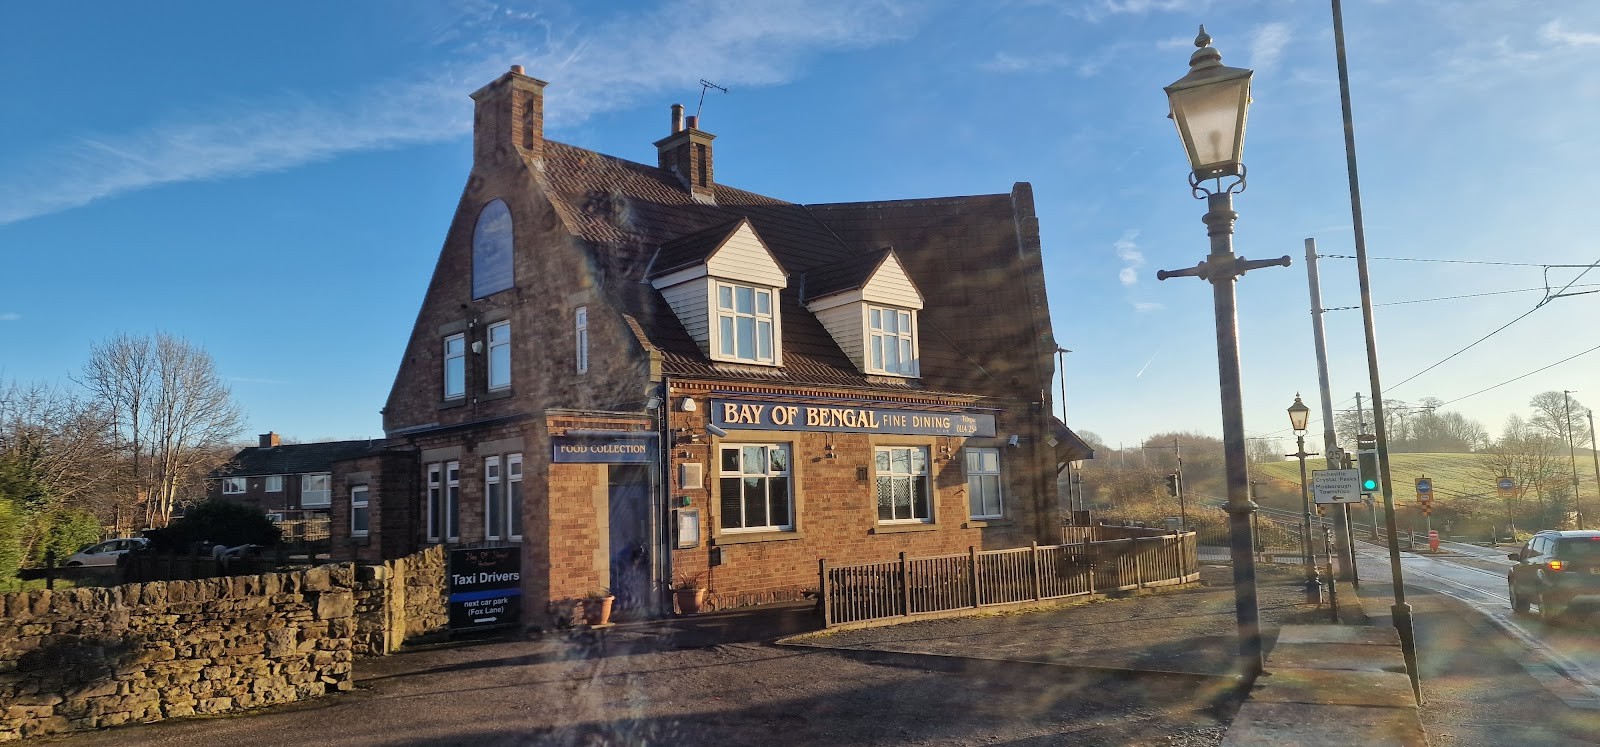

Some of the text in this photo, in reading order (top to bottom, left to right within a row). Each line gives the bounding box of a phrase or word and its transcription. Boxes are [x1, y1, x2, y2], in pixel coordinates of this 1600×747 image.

[722, 402, 765, 424] BAY
[771, 405, 799, 426] OF
[806, 407, 880, 429] BENGAL
[882, 414, 907, 427] FINE
[912, 415, 951, 429] DINING
[560, 444, 647, 454] FOOD COLLECTION
[1328, 450, 1341, 460] 25
[451, 571, 520, 586] Taxi Drivers
[464, 600, 480, 608] next
[492, 597, 508, 606] park
[467, 605, 504, 617] (Fox Lane)
